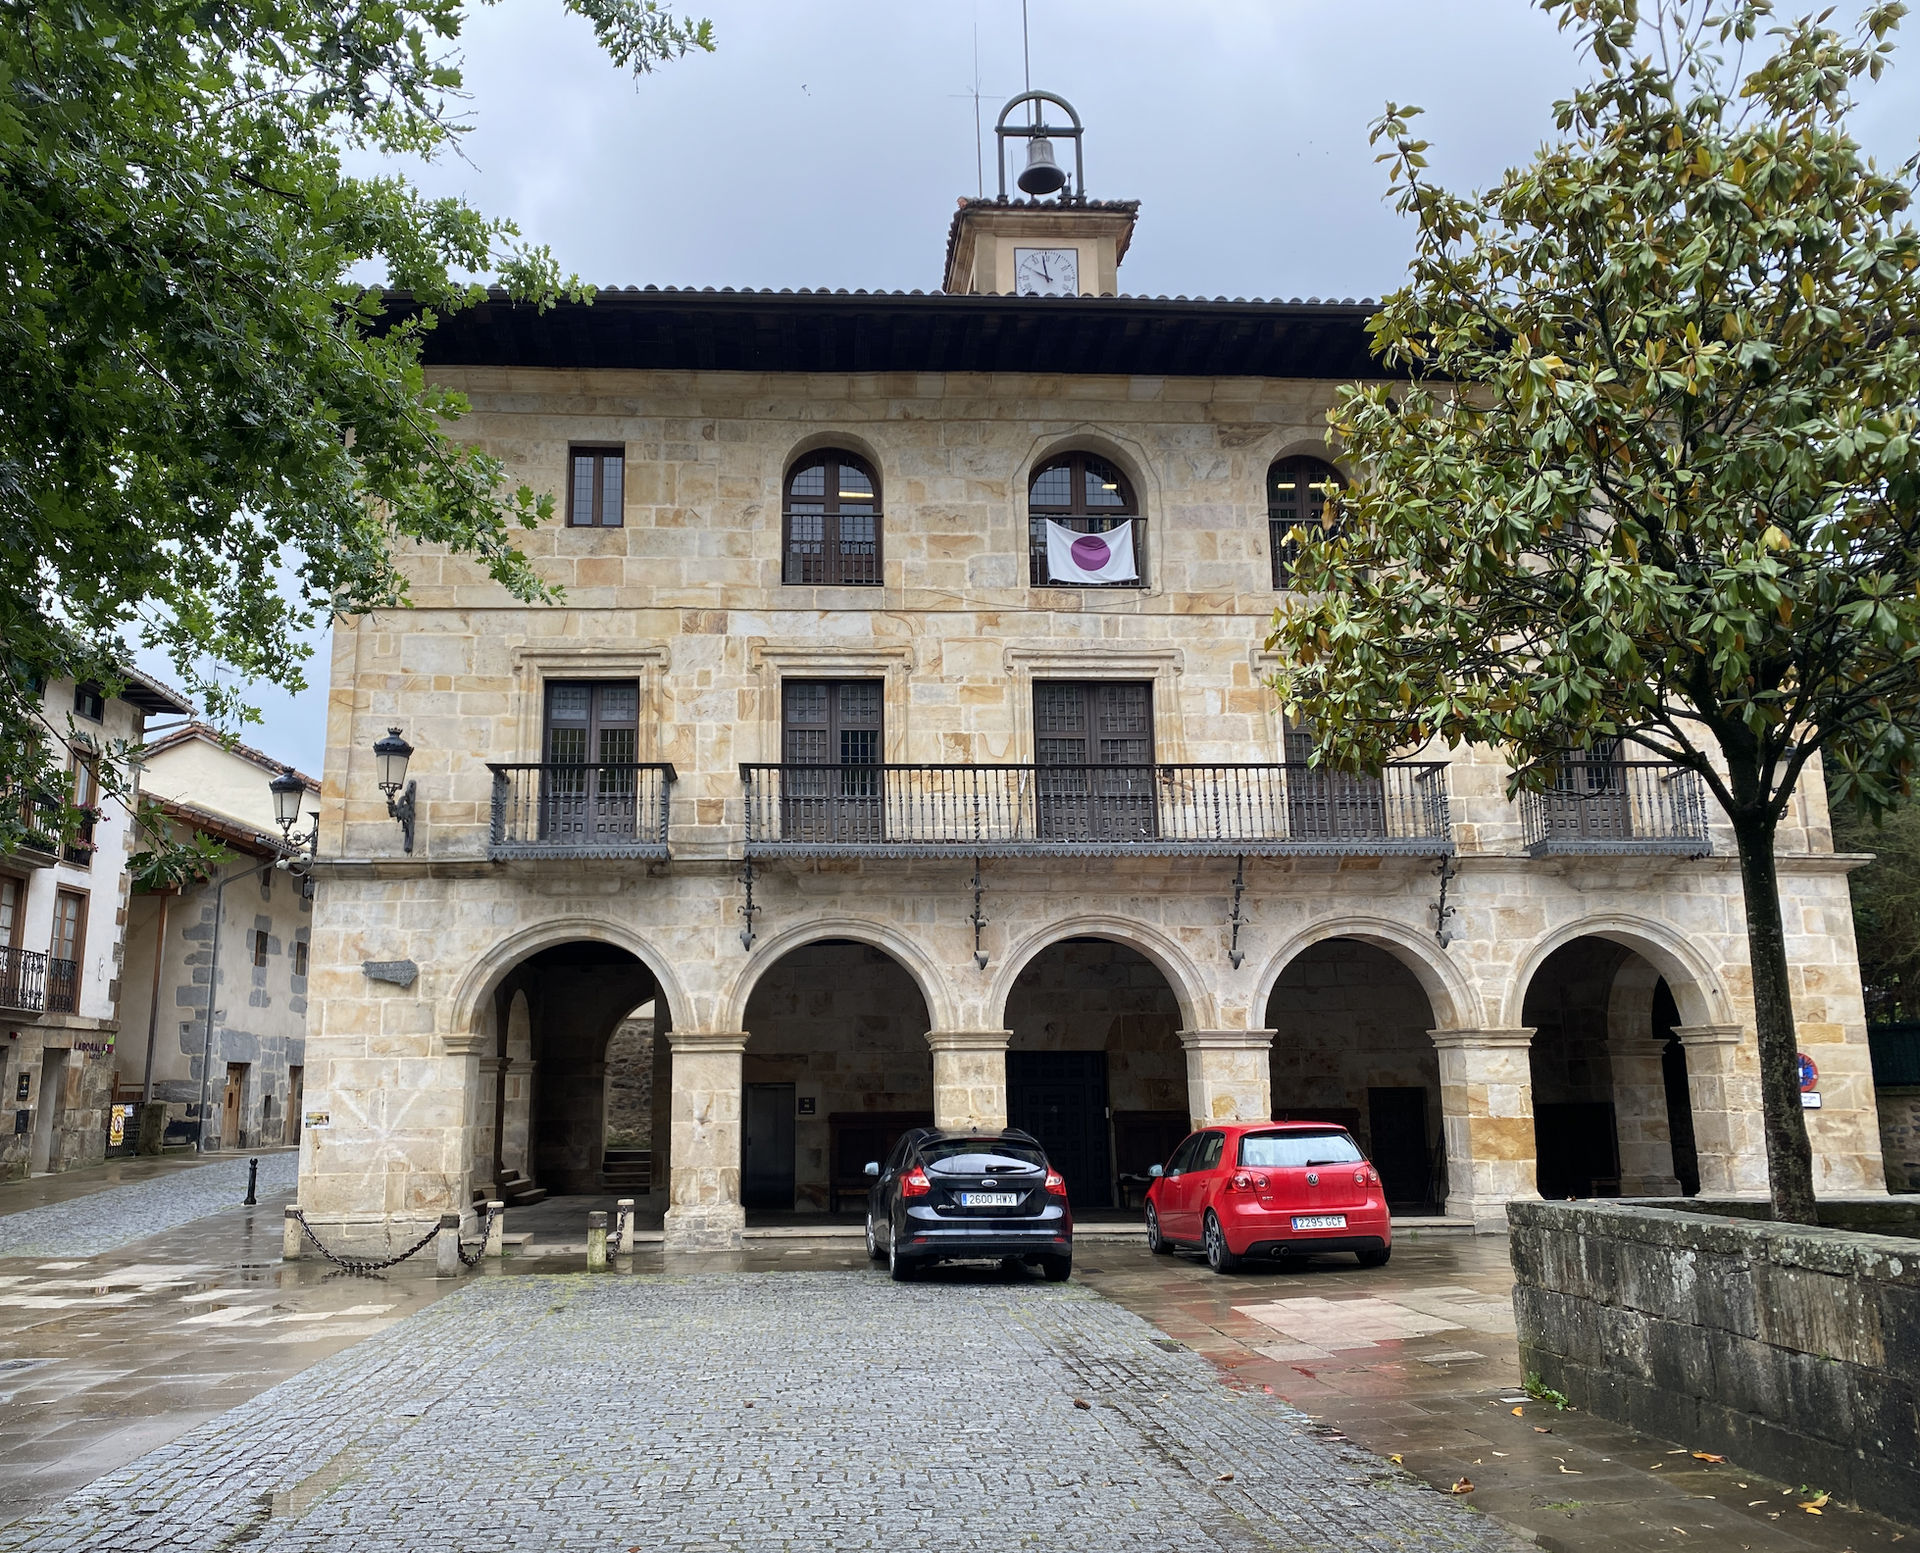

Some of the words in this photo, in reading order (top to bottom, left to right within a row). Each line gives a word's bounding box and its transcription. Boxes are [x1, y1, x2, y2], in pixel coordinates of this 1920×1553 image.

[969, 1194, 993, 1204] 2600
[996, 1194, 1013, 1204] HWX
[1299, 1217, 1323, 1228] 2295
[1325, 1216, 1342, 1227] GCF
